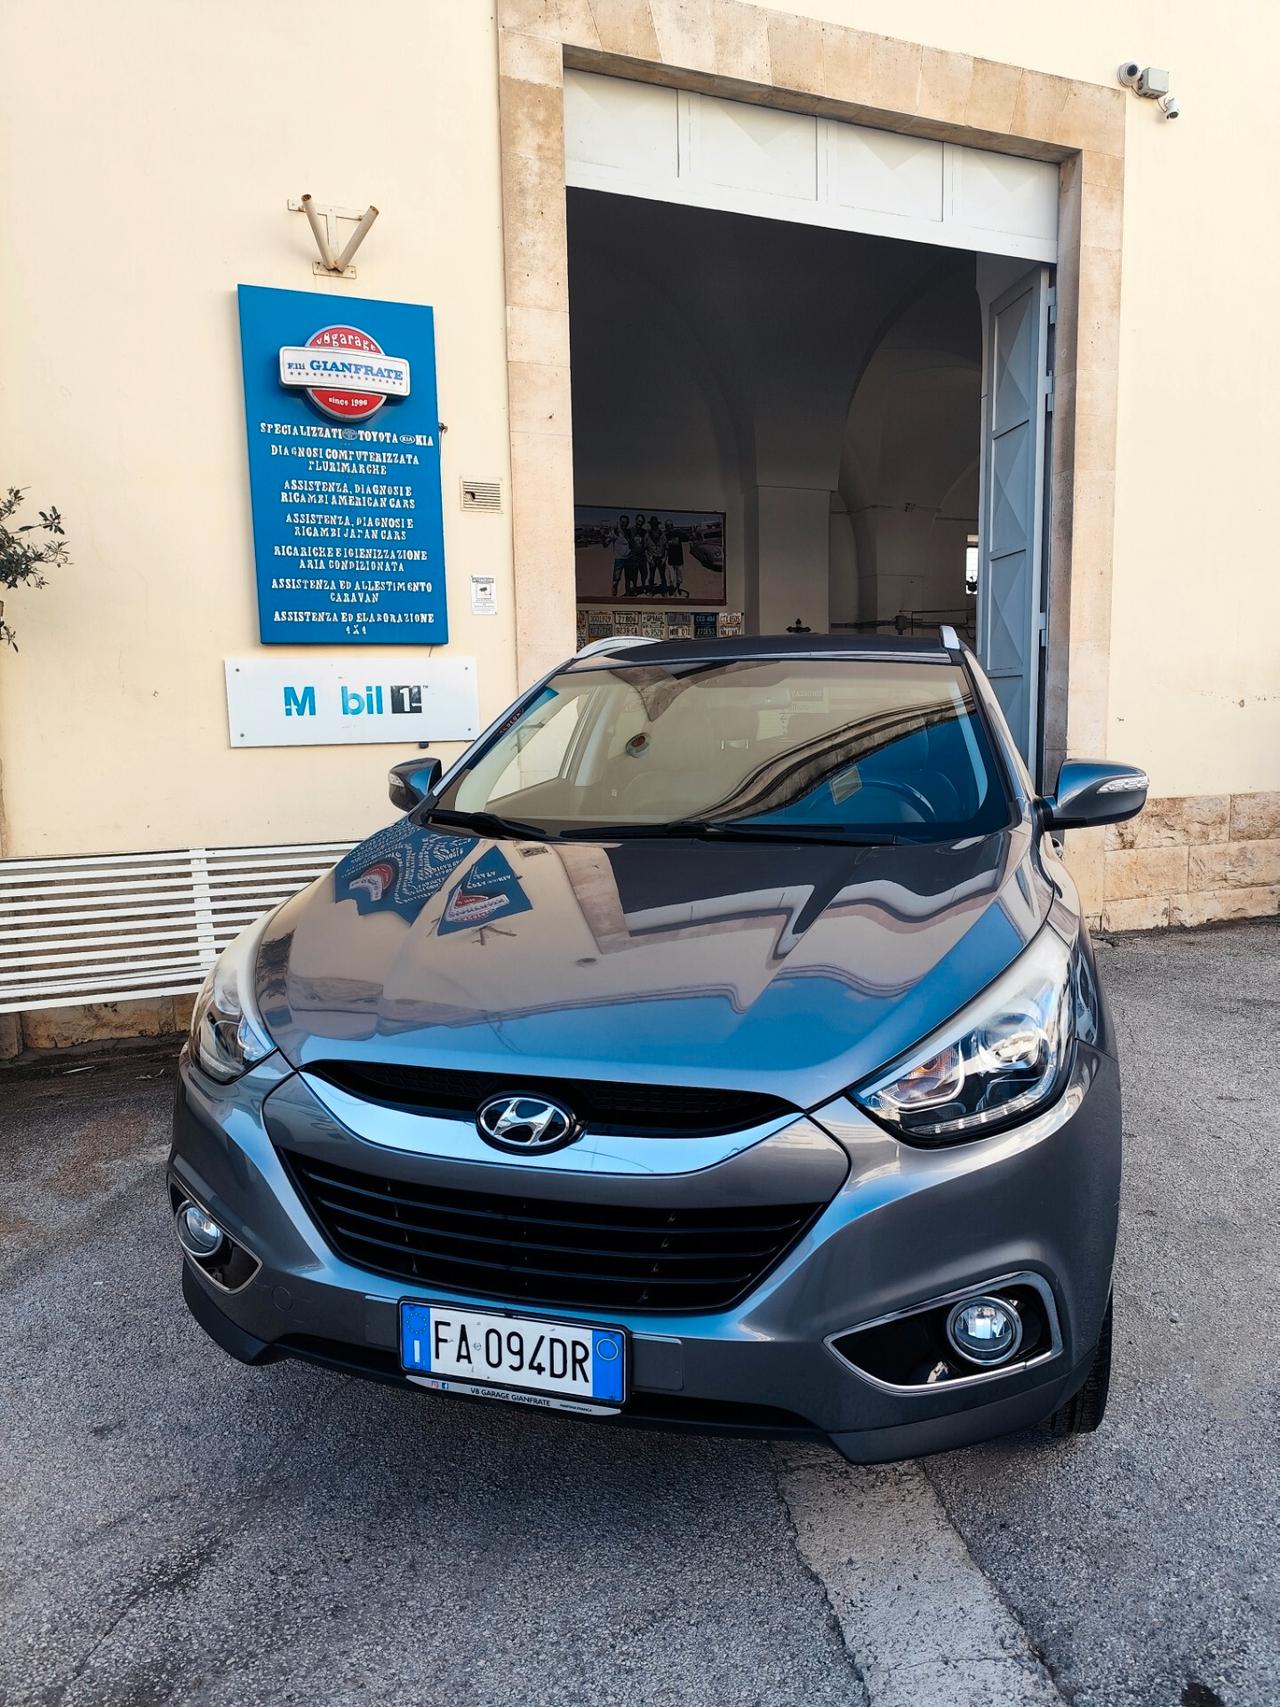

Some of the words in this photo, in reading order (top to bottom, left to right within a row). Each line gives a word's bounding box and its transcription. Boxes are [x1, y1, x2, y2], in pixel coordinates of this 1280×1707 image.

[310, 360, 404, 381] GIANFRATE
[329, 397, 349, 406] since
[260, 423, 342, 439] SPECIALIZZATI
[358, 430, 398, 444] TOYOTA
[415, 434, 434, 447] KIA
[271, 444, 323, 459] DIAGNOSI
[325, 448, 420, 465] COMPUTERIZZATA
[308, 461, 387, 475] PLURIMARCHE
[284, 479, 353, 494] ASSISTENZA,
[355, 483, 403, 496] DIAGNOSI
[406, 486, 412, 496] E
[281, 492, 328, 505] RICAMBI
[331, 495, 387, 508] AMERICAN
[389, 497, 416, 509] CARS
[286, 513, 354, 527] ASSISTENZA,
[356, 516, 404, 528] DIAGNOSI
[407, 518, 413, 528] E
[294, 526, 341, 538] RICAMBI
[343, 528, 378, 539] JAPAN
[380, 530, 407, 541] CARS
[274, 546, 333, 557] RICARICHE
[336, 547, 342, 557] E
[344, 548, 427, 561] IGIENIZZAZIONE
[299, 559, 326, 570] ARIA
[328, 560, 405, 572] CONDIZIONATA
[272, 578, 336, 590] ASSISTENZA
[340, 580, 352, 590] ED
[354, 581, 432, 593] ALLESTIMENTO
[330, 592, 379, 603] CARAVAN
[274, 611, 338, 622] ASSISTENZA
[341, 612, 354, 622] ED
[356, 612, 435, 623] ELABORAZIONE
[434, 1320, 473, 1365] FA
[485, 1328, 590, 1383] 094DR
[470, 1387, 480, 1395] V8
[481, 1388, 510, 1400] GARAGE
[511, 1393, 551, 1407] GIANFRATE
